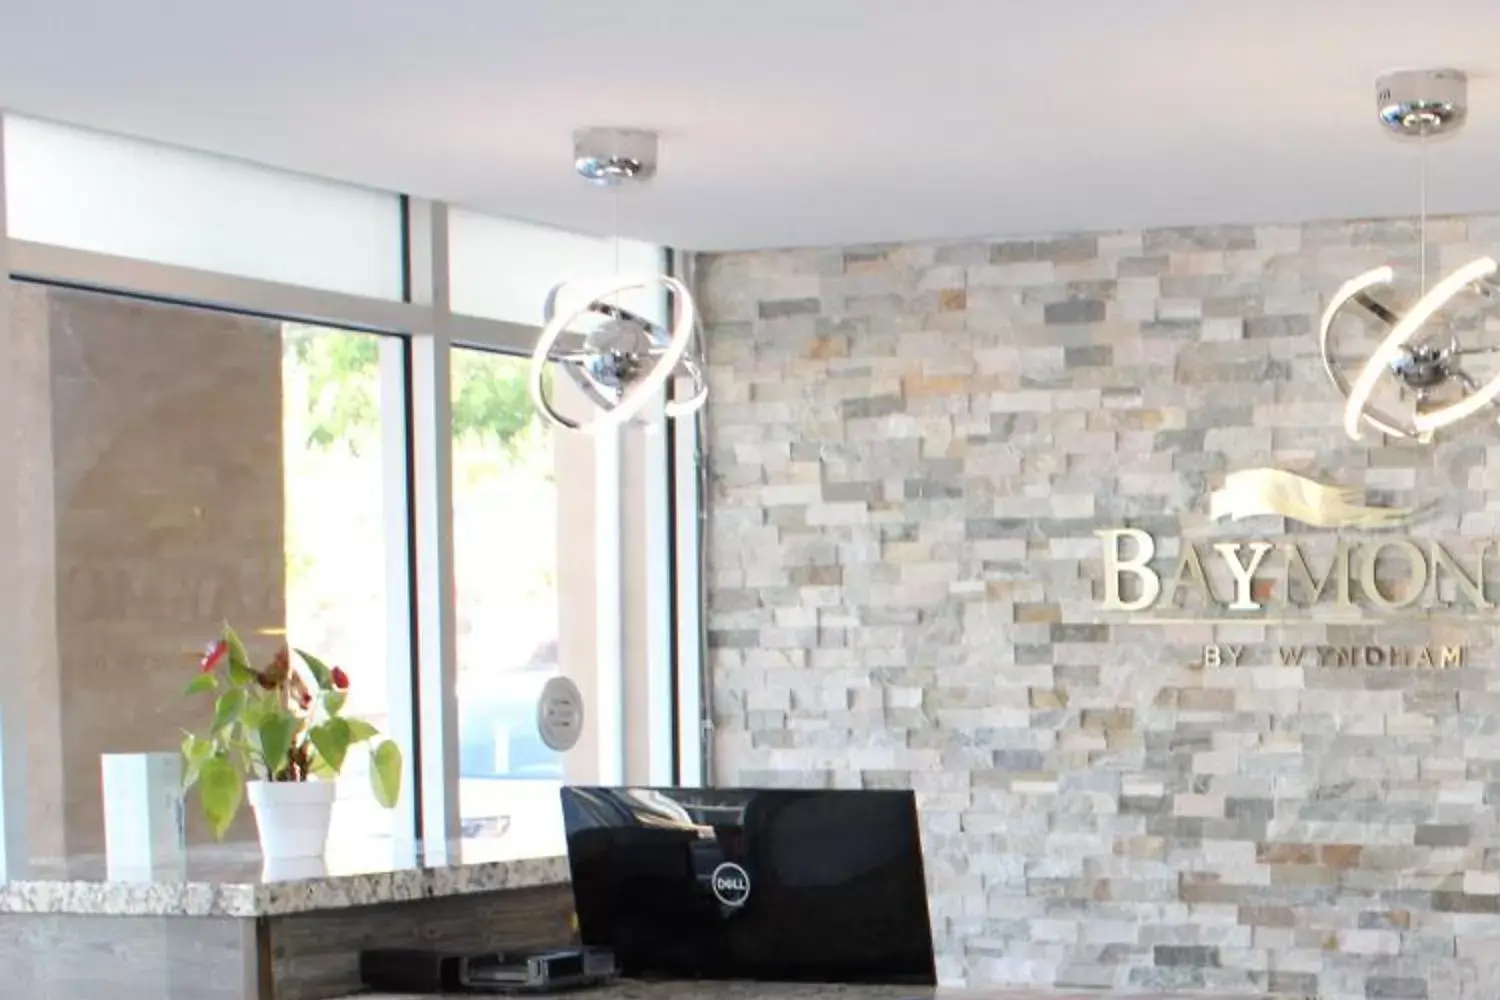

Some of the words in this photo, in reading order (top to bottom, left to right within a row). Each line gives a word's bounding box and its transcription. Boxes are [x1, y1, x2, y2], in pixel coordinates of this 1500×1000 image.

[1204, 645, 1244, 668] BY
[1278, 645, 1465, 669] WYNDHAM
[717, 877, 746, 890] DELL
